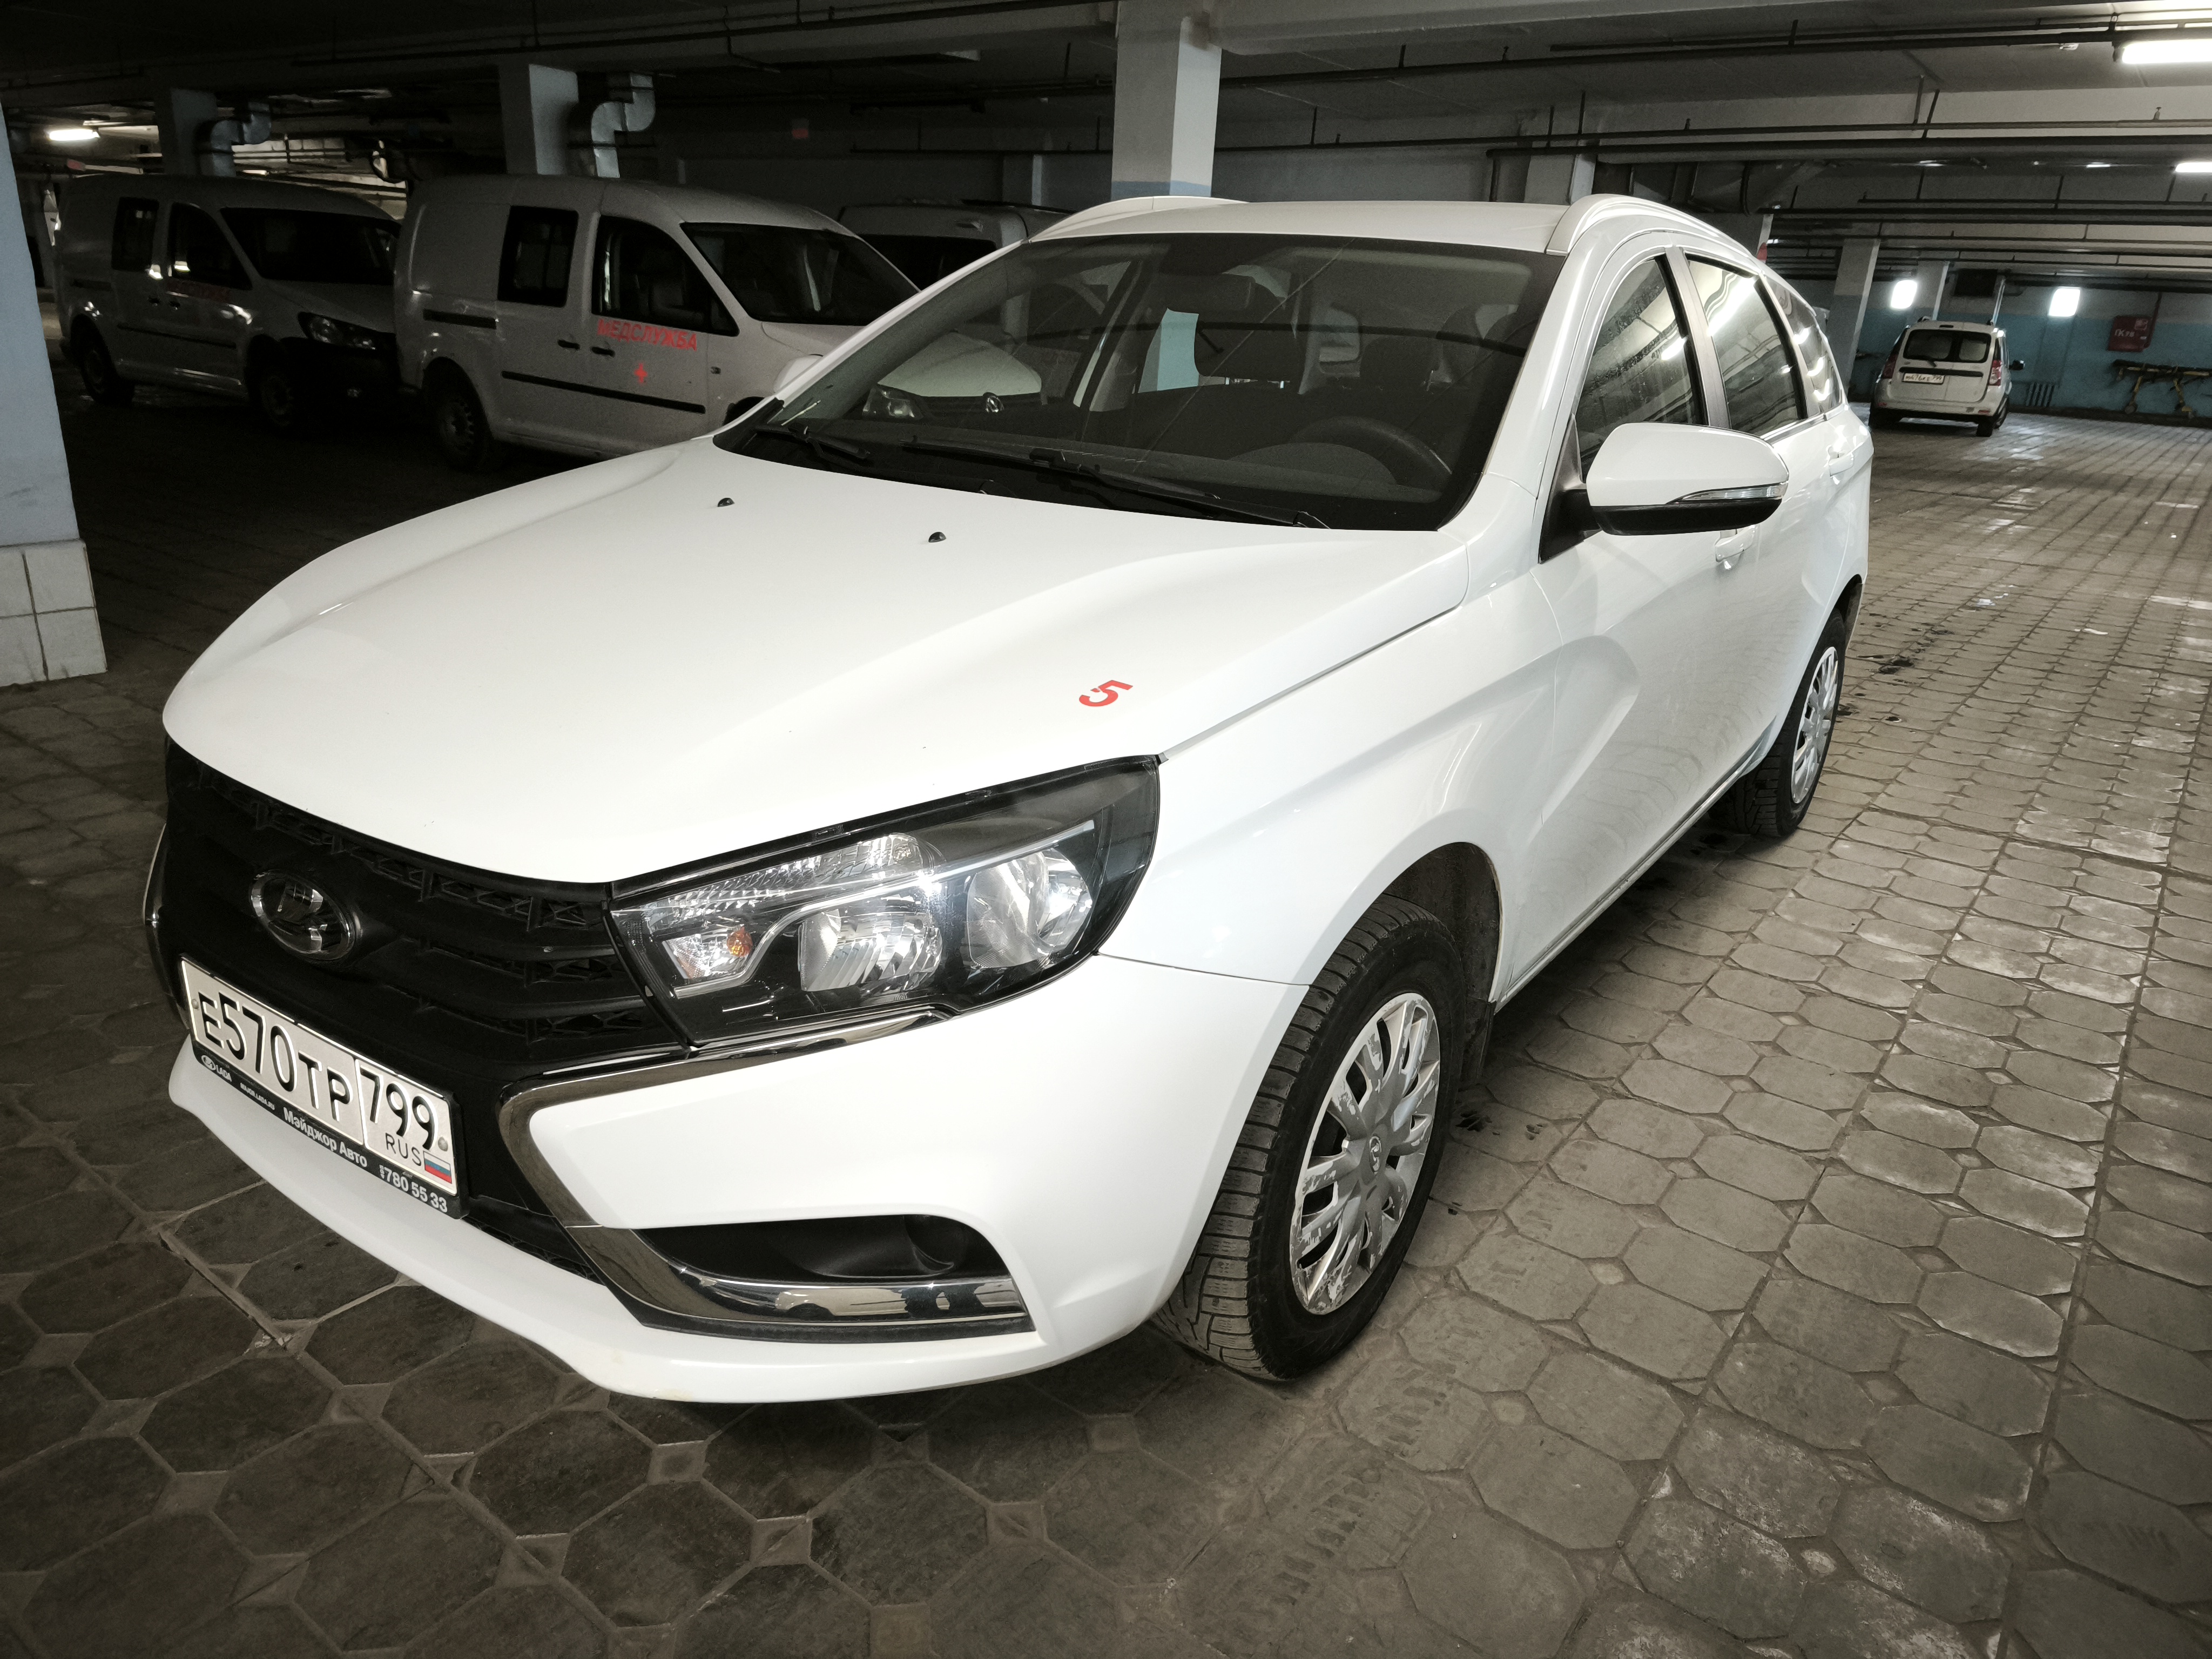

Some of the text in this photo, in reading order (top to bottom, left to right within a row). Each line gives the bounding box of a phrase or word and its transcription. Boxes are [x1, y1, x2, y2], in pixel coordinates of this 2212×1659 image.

[597, 319, 697, 352] МЕДСЛУЖБА
[1079, 680, 1134, 707] 5
[198, 990, 439, 1150] Е570ТР 799
[216, 1064, 232, 1082] LADA
[283, 1107, 368, 1168] Мэйджор Авто
[385, 1132, 422, 1166] RUS
[384, 1166, 409, 1192] 780
[411, 1182, 428, 1203] 55
[430, 1192, 448, 1213] 33
